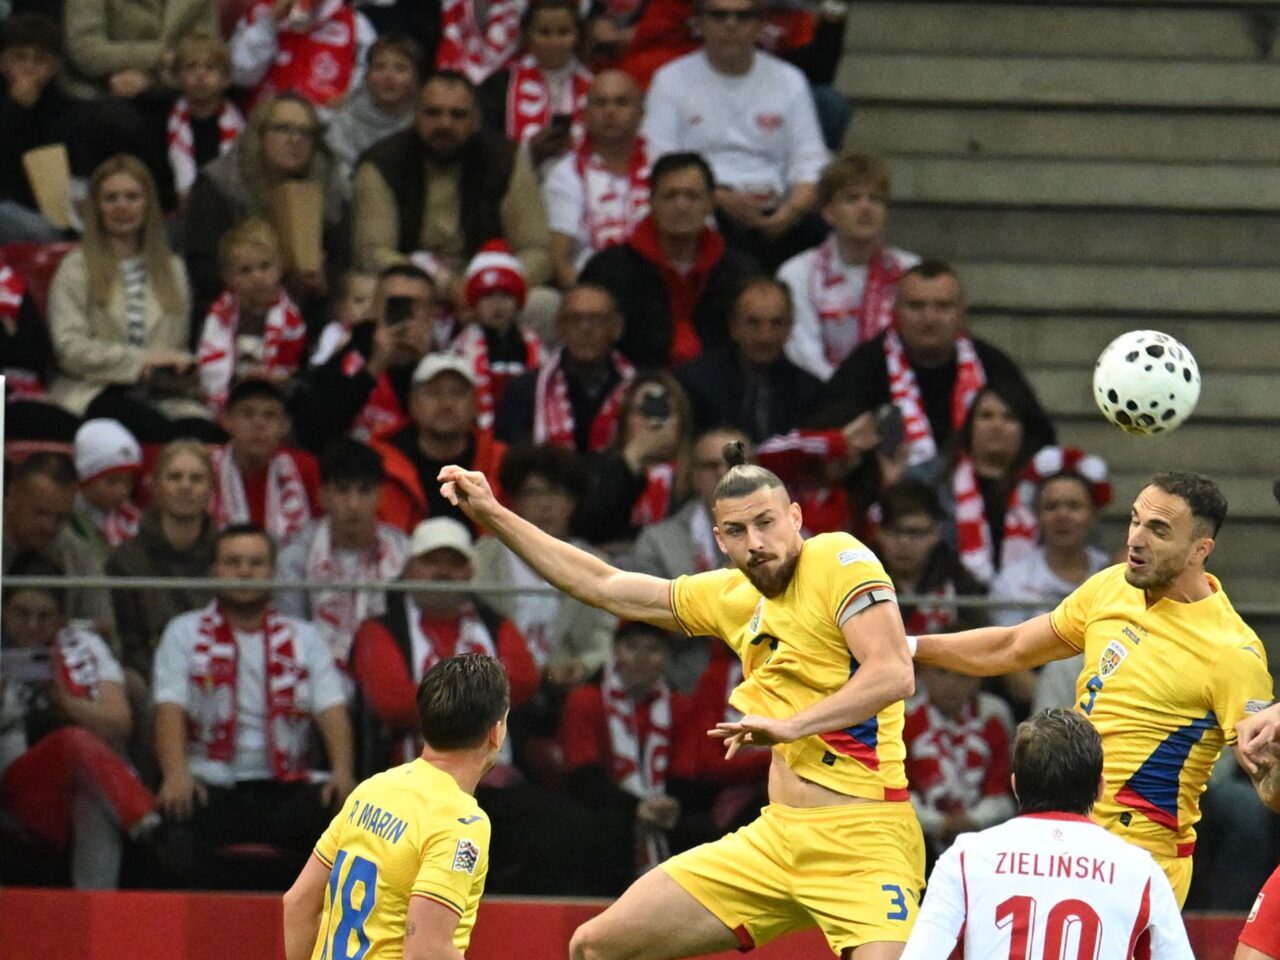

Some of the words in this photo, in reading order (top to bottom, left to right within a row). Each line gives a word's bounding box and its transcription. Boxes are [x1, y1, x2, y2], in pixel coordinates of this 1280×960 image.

[356, 803, 408, 844] MARIN
[995, 852, 1115, 884] ZIELIŃSKI
[881, 884, 909, 922] 3
